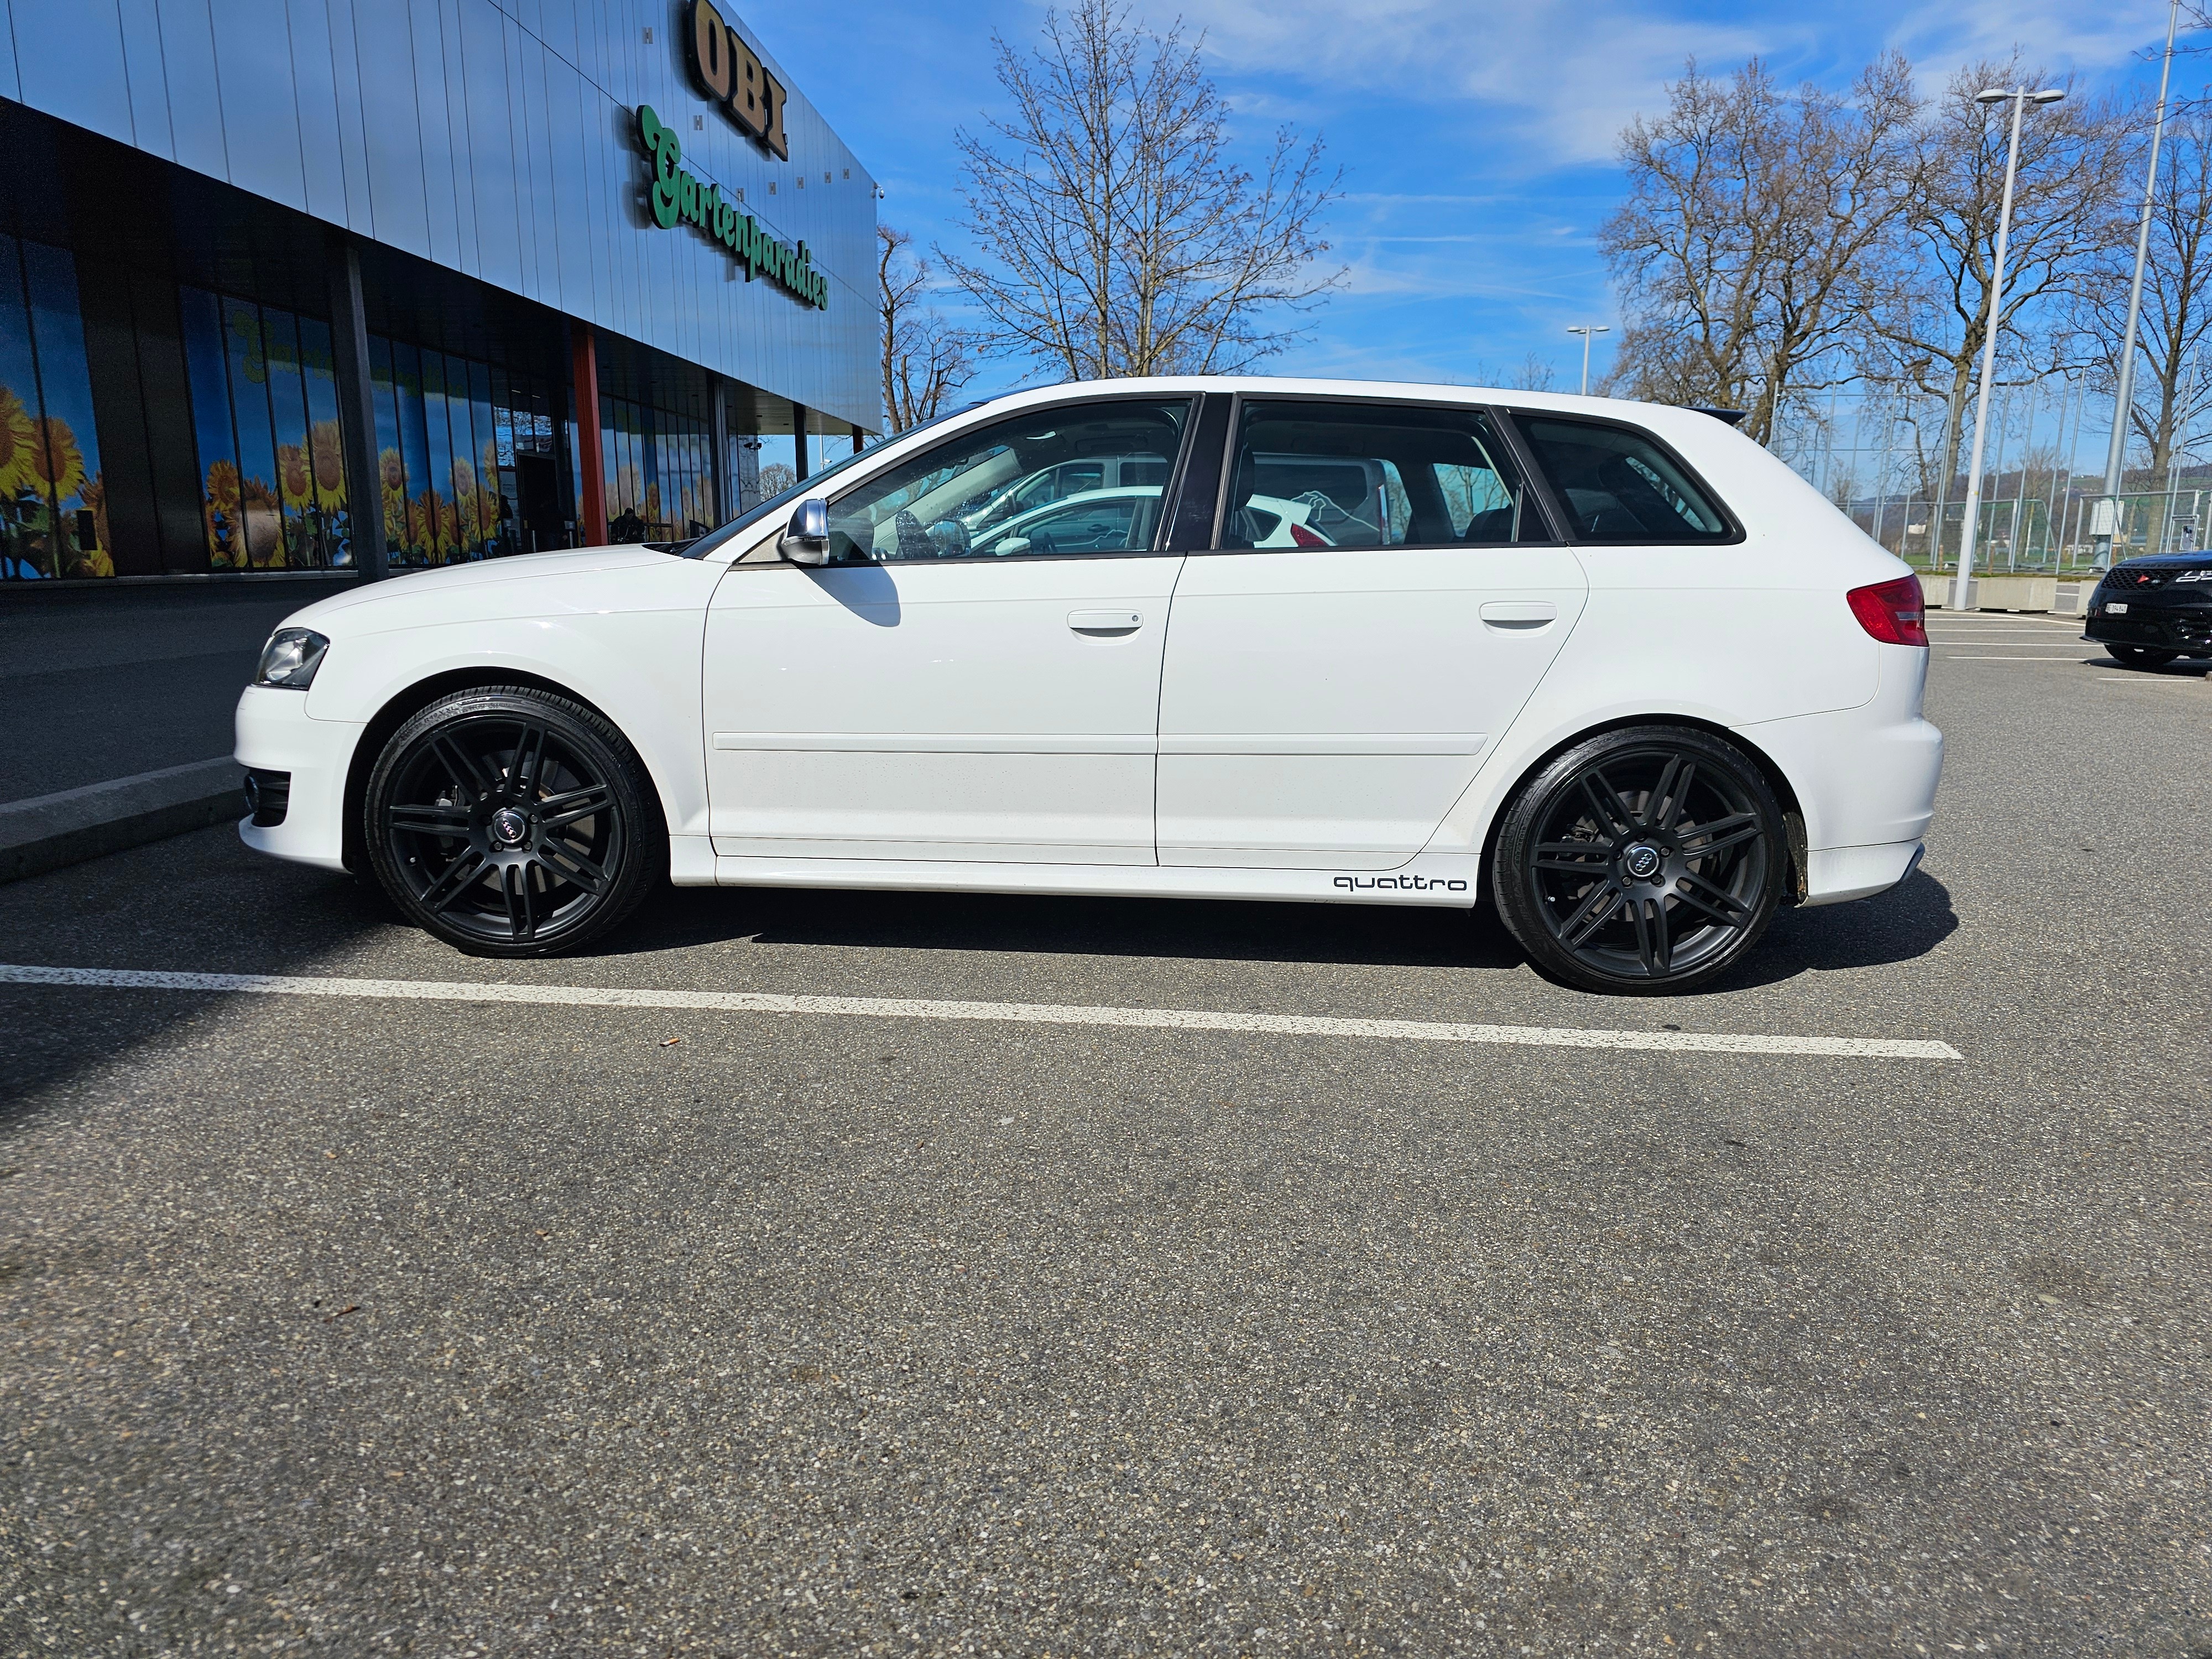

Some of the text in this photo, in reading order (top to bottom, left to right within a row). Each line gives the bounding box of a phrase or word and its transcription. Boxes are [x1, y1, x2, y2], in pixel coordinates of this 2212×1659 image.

[689, 0, 788, 161] OBI
[636, 105, 828, 311] Gartenparadies
[1333, 874, 1467, 892] quattro
